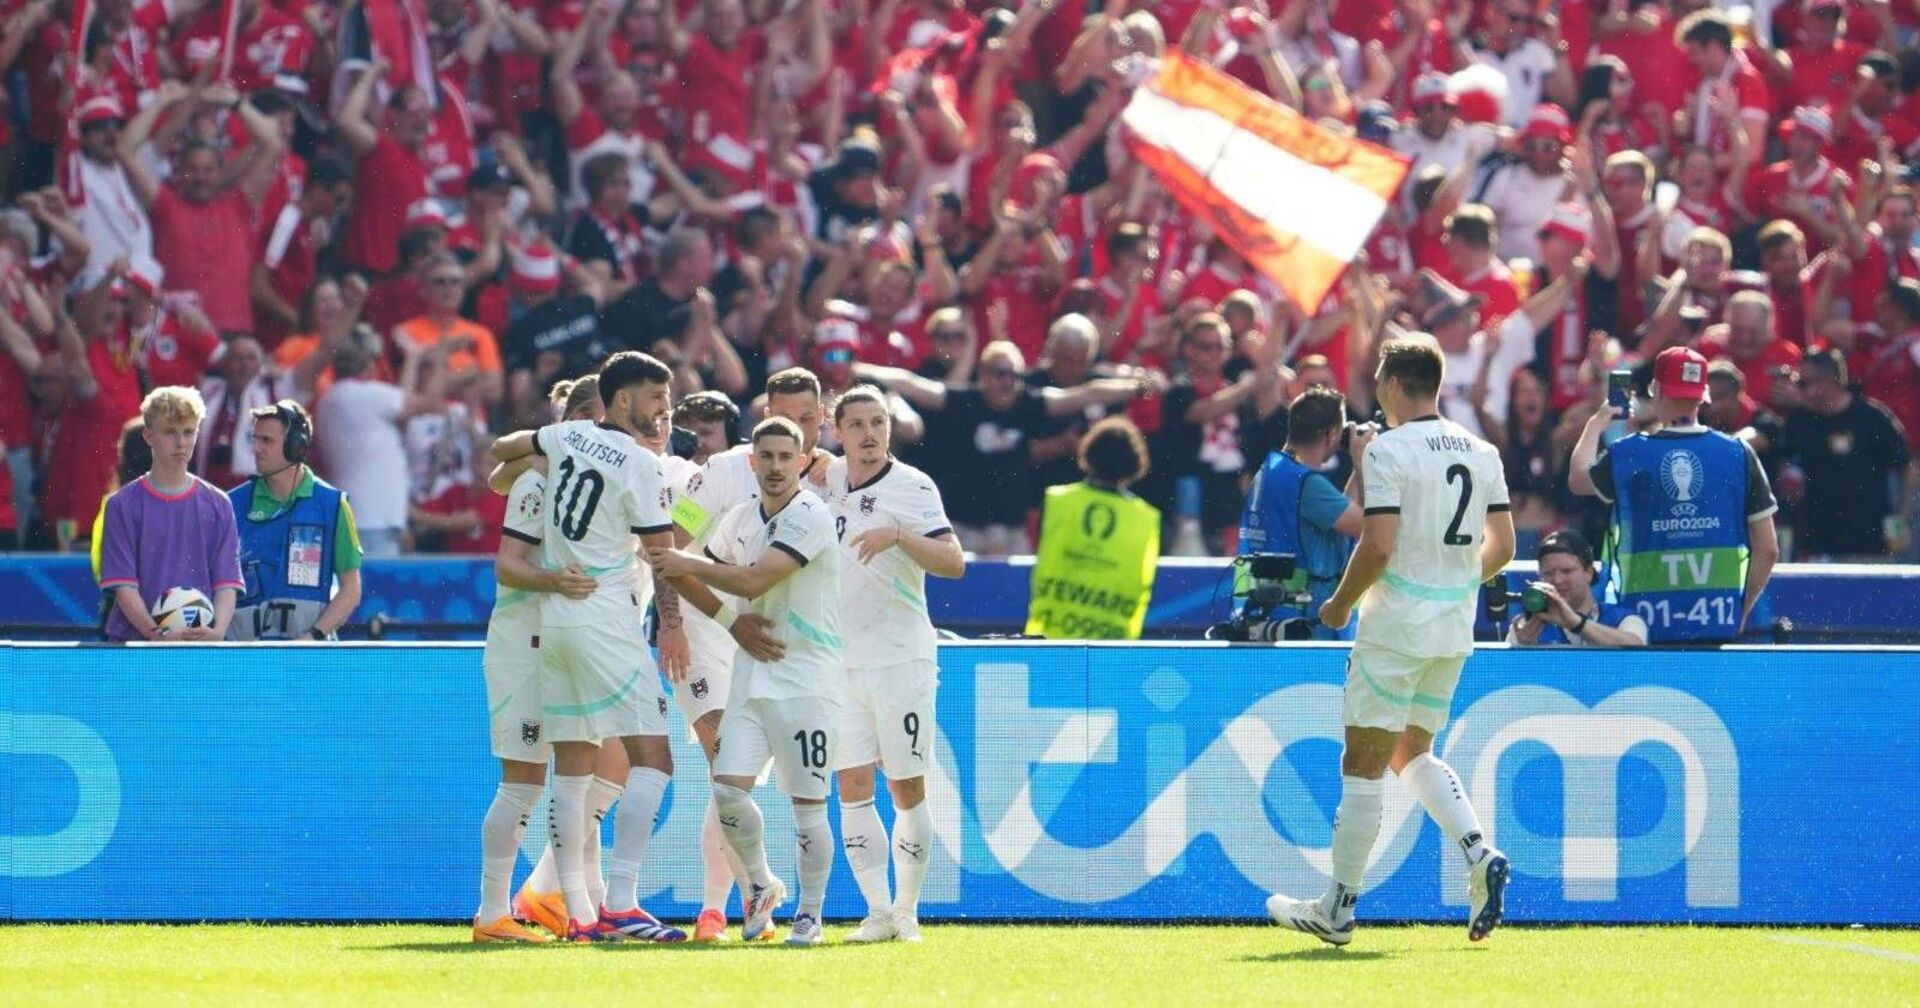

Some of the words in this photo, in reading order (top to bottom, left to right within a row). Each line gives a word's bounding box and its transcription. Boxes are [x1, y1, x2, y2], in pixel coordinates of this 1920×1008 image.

[553, 455, 605, 541] 10
[1443, 463, 1473, 545] 2
[1652, 516, 1721, 532] EURO2024
[1660, 552, 1714, 586] TV
[794, 729, 828, 769] 18
[904, 711, 920, 750] 9
